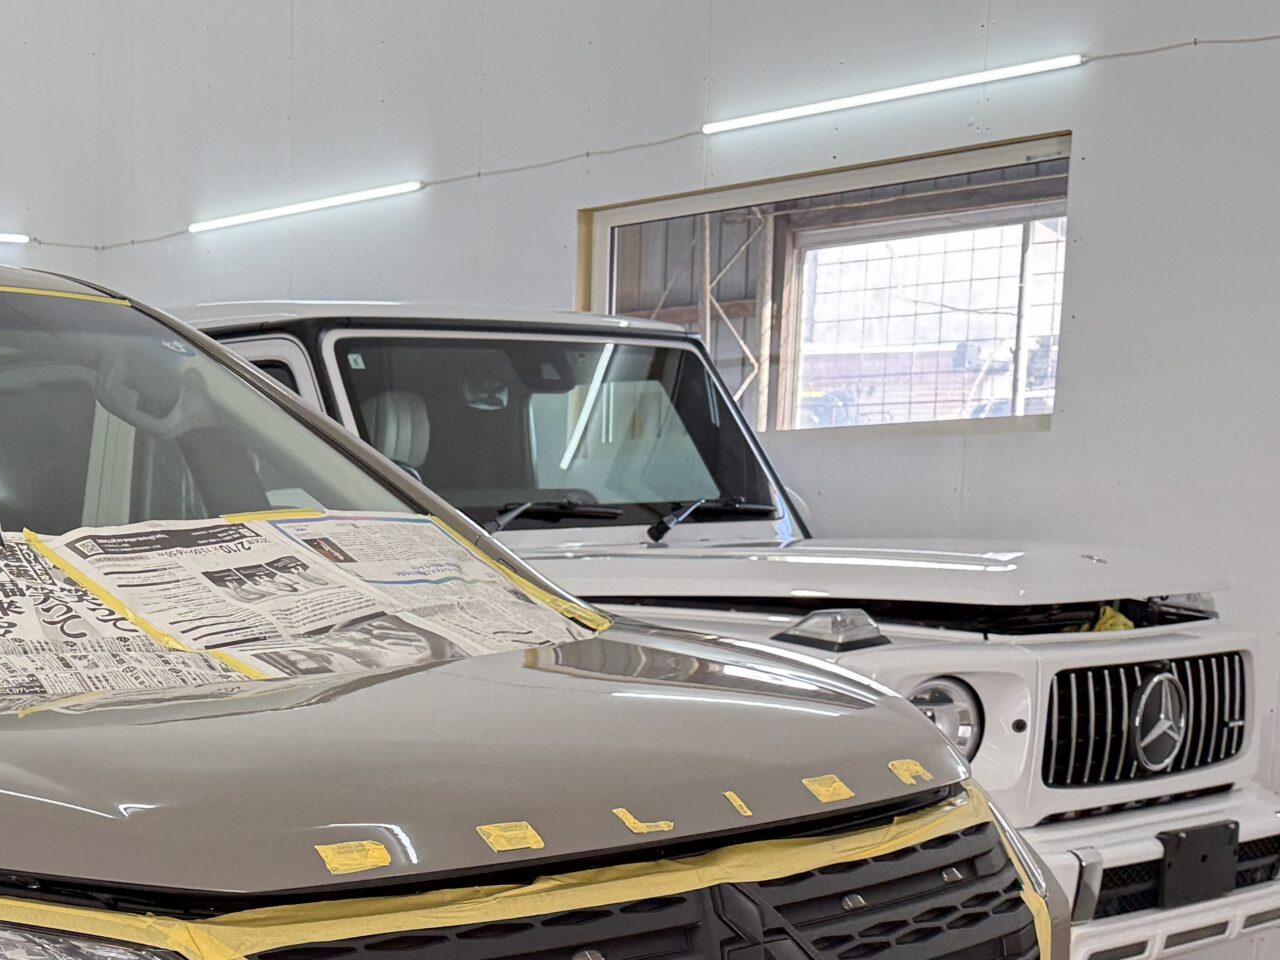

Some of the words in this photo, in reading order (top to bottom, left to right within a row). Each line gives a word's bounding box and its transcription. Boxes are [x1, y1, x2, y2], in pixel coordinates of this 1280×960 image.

[219, 541, 252, 554] 2/10
[25, 584, 88, 639] 笑って
